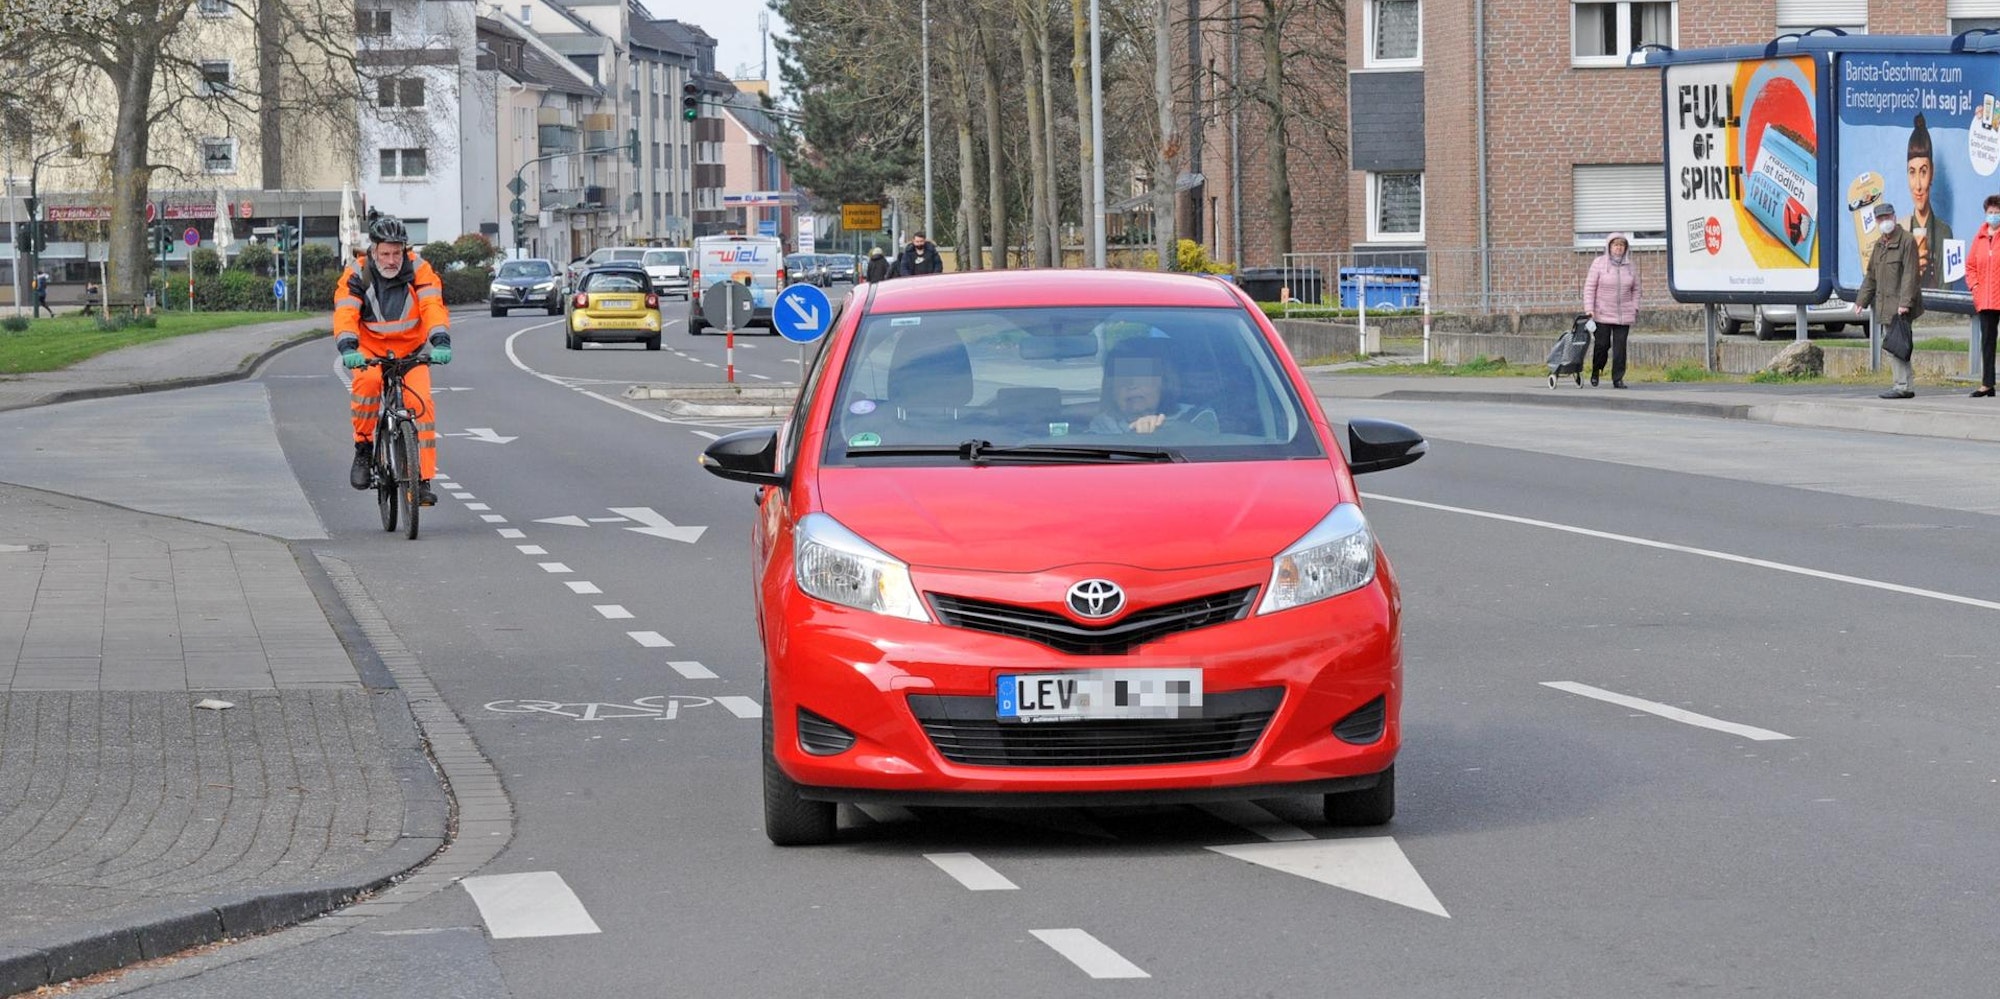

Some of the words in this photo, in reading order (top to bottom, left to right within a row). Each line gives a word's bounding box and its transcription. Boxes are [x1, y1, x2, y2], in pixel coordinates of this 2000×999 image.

[1845, 60, 1938, 82] Barista-Geschmack
[1940, 67, 1962, 82] zum
[1678, 84, 1741, 130] FULL
[1845, 87, 1920, 113] Einsteigerpreis?
[1922, 89, 1937, 109] Ich
[1938, 94, 1957, 115] sag
[1958, 89, 1972, 116] ja!
[1692, 133, 1714, 160] OF
[1680, 165, 1743, 201] SPIRIT
[1762, 161, 1774, 175] ist
[1774, 171, 1805, 202] tödlich
[1946, 246, 1962, 276] ja!
[1003, 701, 1011, 710] D
[1018, 679, 1074, 710] LEV
